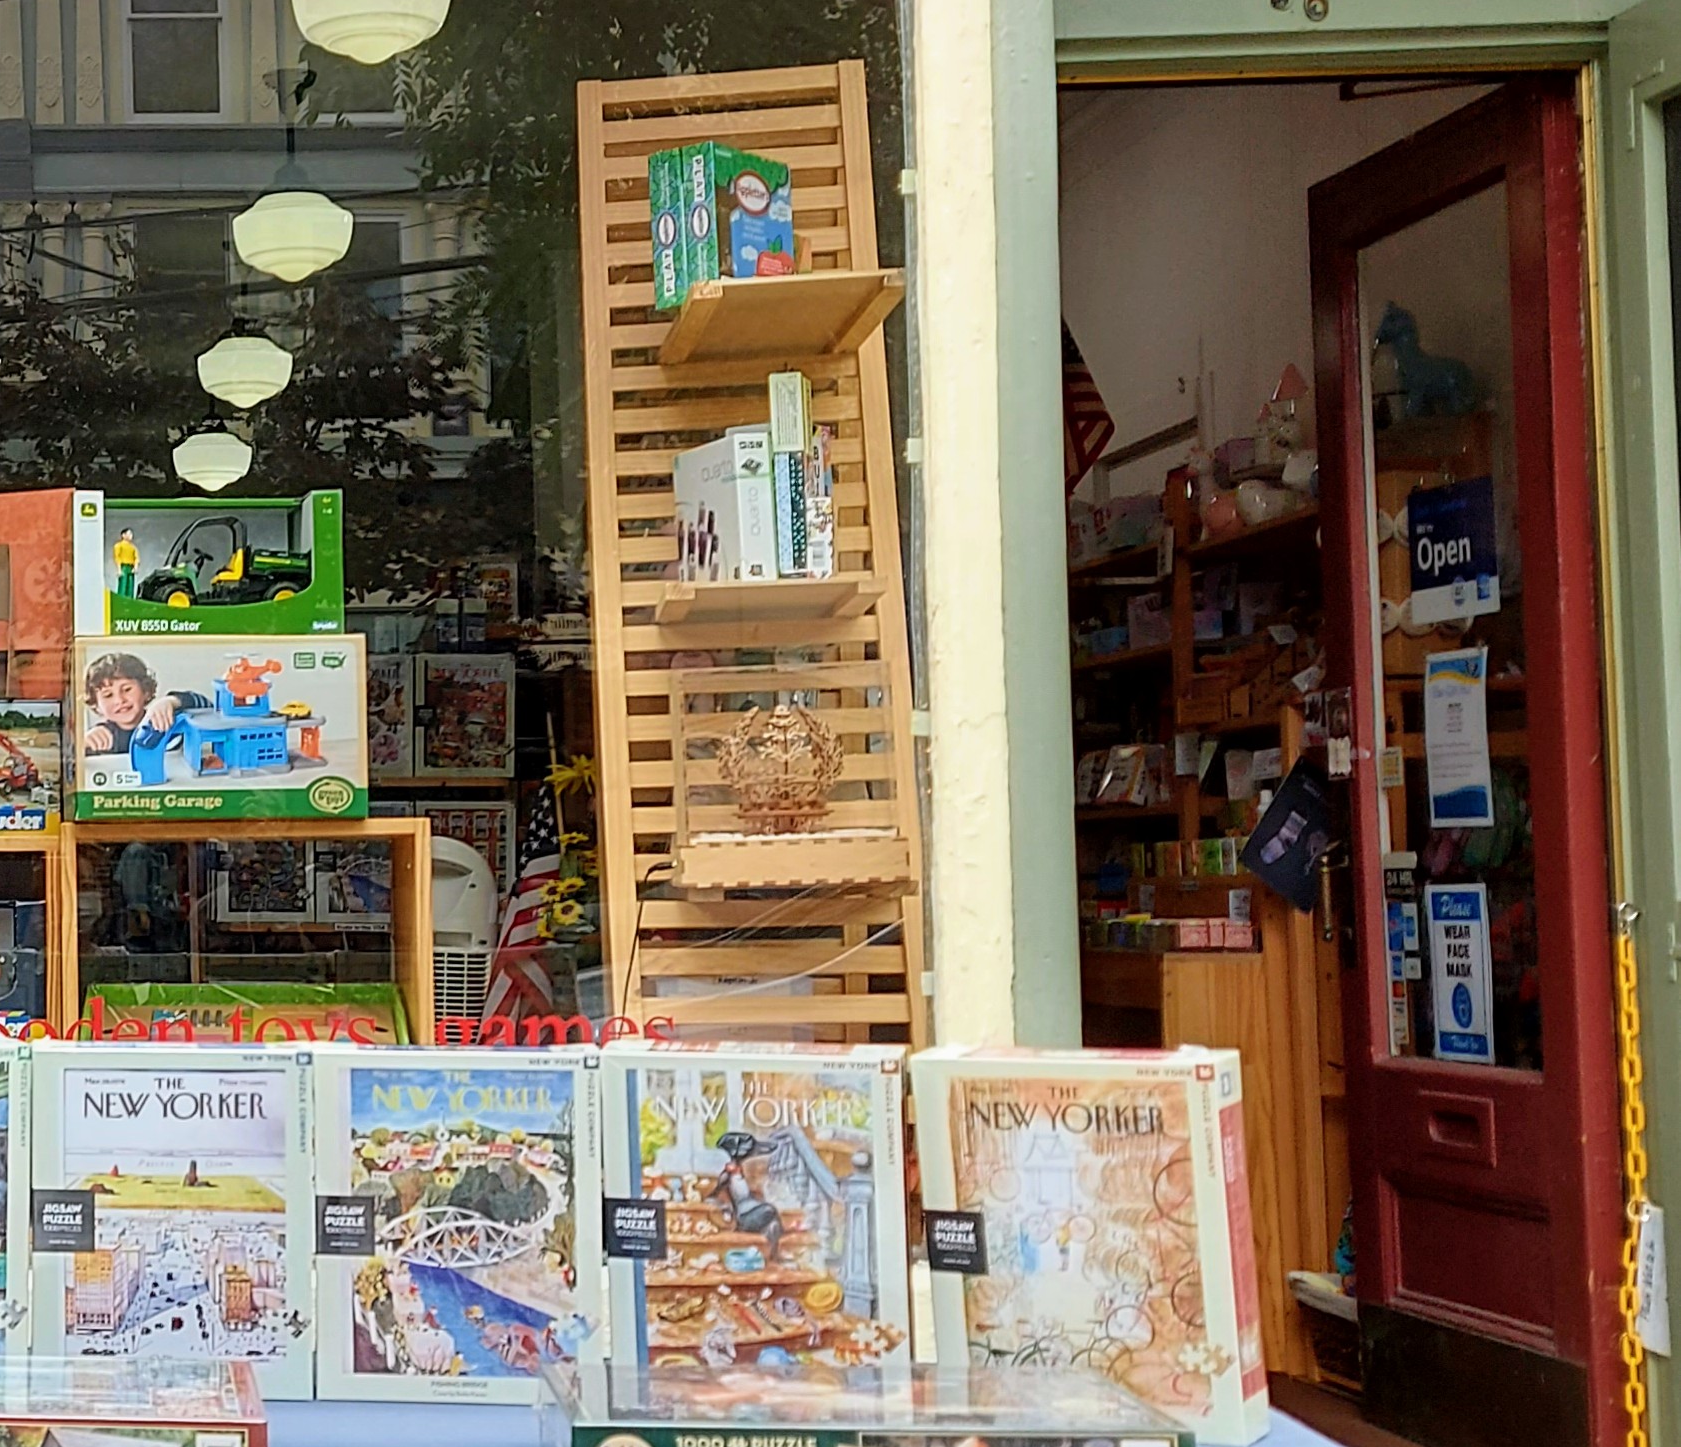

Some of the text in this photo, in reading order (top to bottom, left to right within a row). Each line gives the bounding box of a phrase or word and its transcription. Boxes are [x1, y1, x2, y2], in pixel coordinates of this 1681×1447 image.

[1417, 535, 1472, 577] Open
[114, 620, 140, 632] XUV
[170, 620, 202, 632] Gator
[116, 774, 123, 784] 5
[92, 793, 223, 811] Parking Garage
[1440, 894, 1472, 918] Please
[1443, 925, 1471, 940] WEAR
[1446, 944, 1471, 959] FACE
[1446, 962, 1473, 978] MASK
[153, 1077, 186, 1090] THE
[739, 1080, 770, 1095] THE
[372, 1083, 553, 1114] NEW YORKER
[1047, 1085, 1081, 1099] THE
[83, 1091, 268, 1121] NEW YORKER
[655, 1096, 856, 1129] NEW YORKER
[968, 1100, 1165, 1136] NEW YORKER
[42, 1203, 83, 1214] JIGSAW
[324, 1204, 366, 1216] JIGSAW
[614, 1207, 657, 1219] JIGSAW
[42, 1213, 83, 1225] PUZZLE
[324, 1215, 366, 1227] PUZZLE
[614, 1219, 657, 1231] PUZZLE
[934, 1219, 975, 1232] JIGSAW
[934, 1232, 976, 1244] PUZZLE
